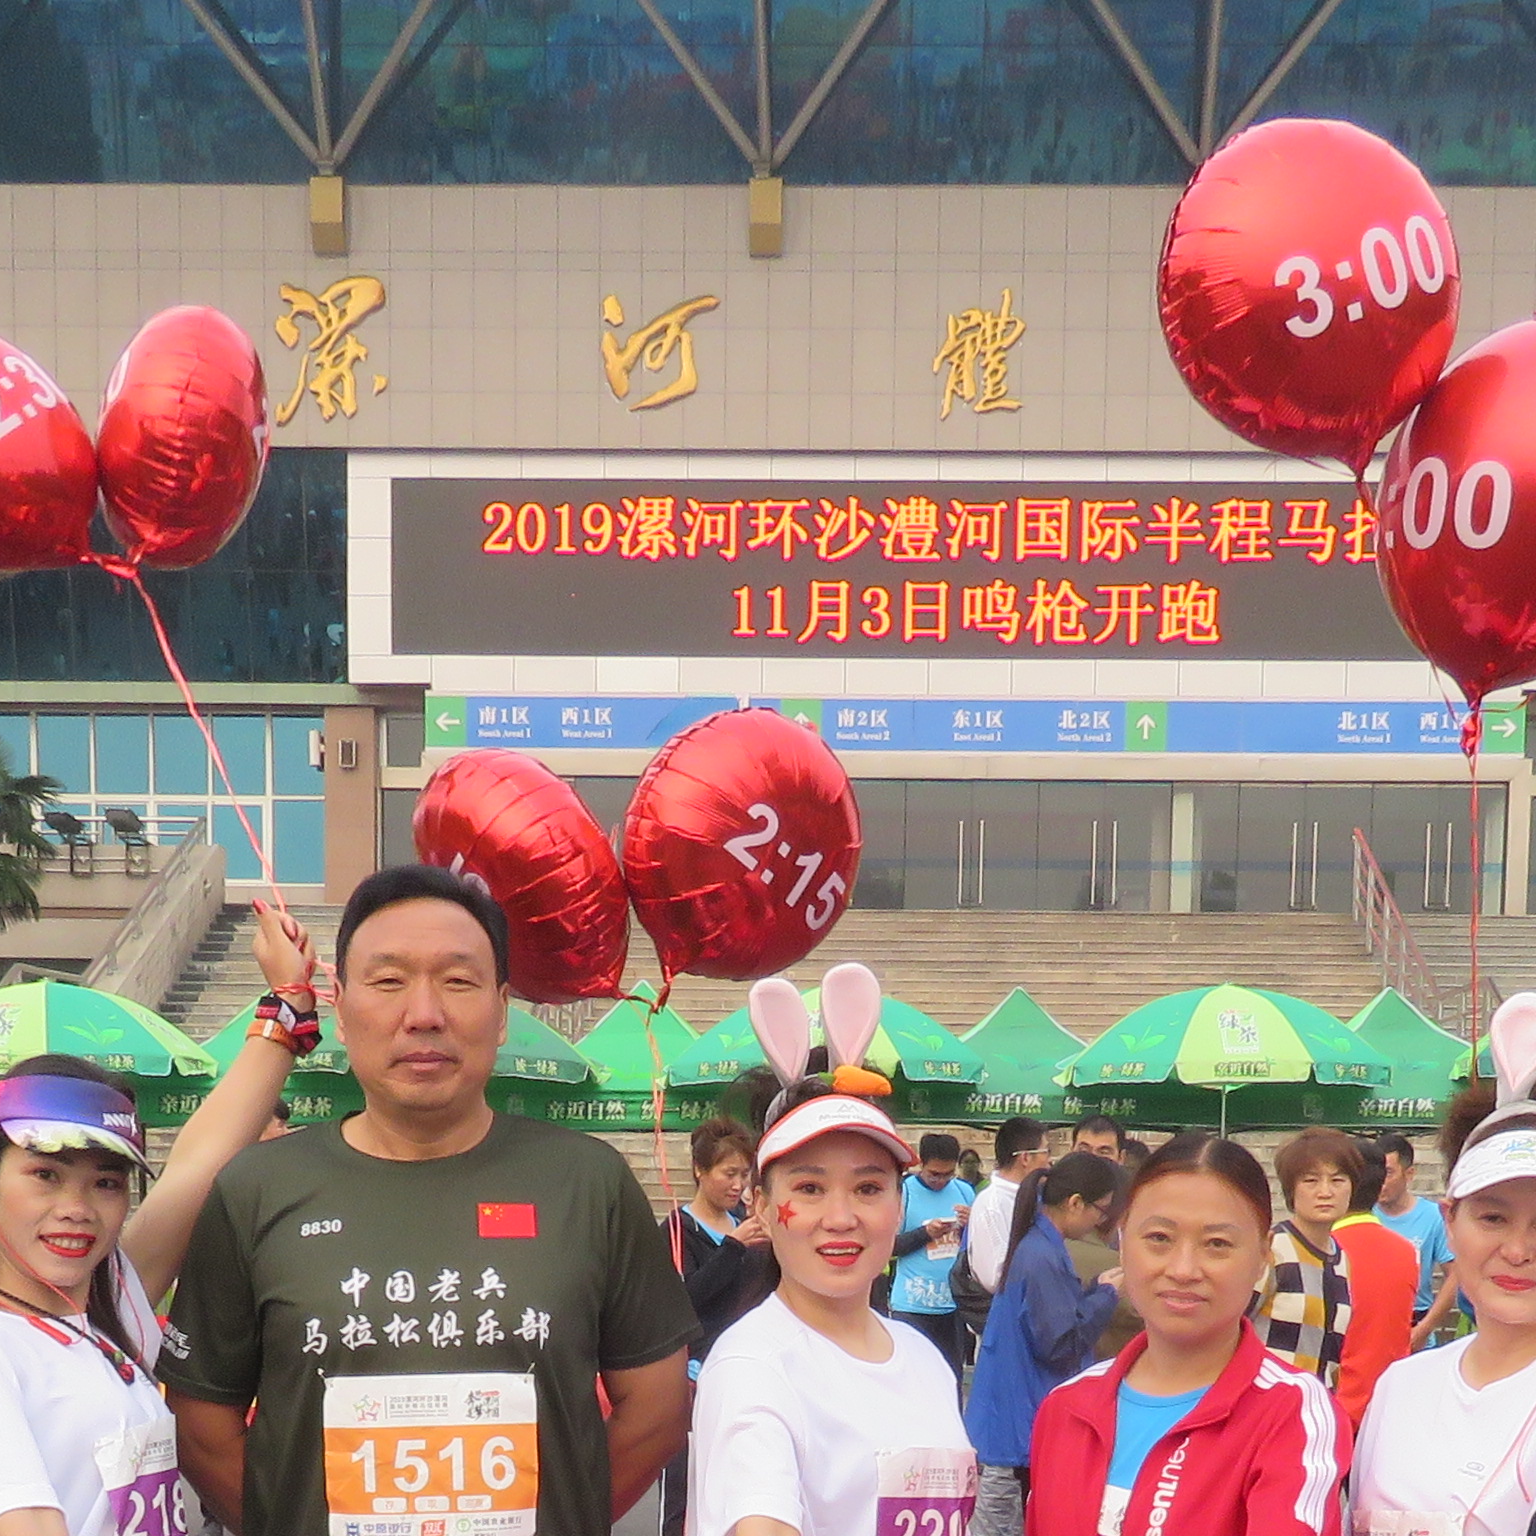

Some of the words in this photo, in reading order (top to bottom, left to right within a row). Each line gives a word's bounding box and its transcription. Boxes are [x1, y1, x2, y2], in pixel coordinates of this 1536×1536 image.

[1273, 215, 1446, 339] 3:00
[1384, 455, 1514, 551] :00
[730, 582, 1222, 648] 11月3日鸣枪开跑
[723, 802, 848, 931] 2:15
[1215, 1061, 1271, 1077] 亲近自然
[160, 1094, 207, 1115] 亲近
[547, 1100, 626, 1121] 亲近自然
[965, 1092, 1043, 1115] 亲近自然
[1063, 1095, 1138, 1117] 统一绿茶
[1357, 1097, 1436, 1119] 亲近自然
[300, 1218, 343, 1238] 8830
[339, 1266, 508, 1309] 中国老兵
[301, 1306, 552, 1356] 马拉松俱乐部
[351, 1435, 517, 1494] 1516
